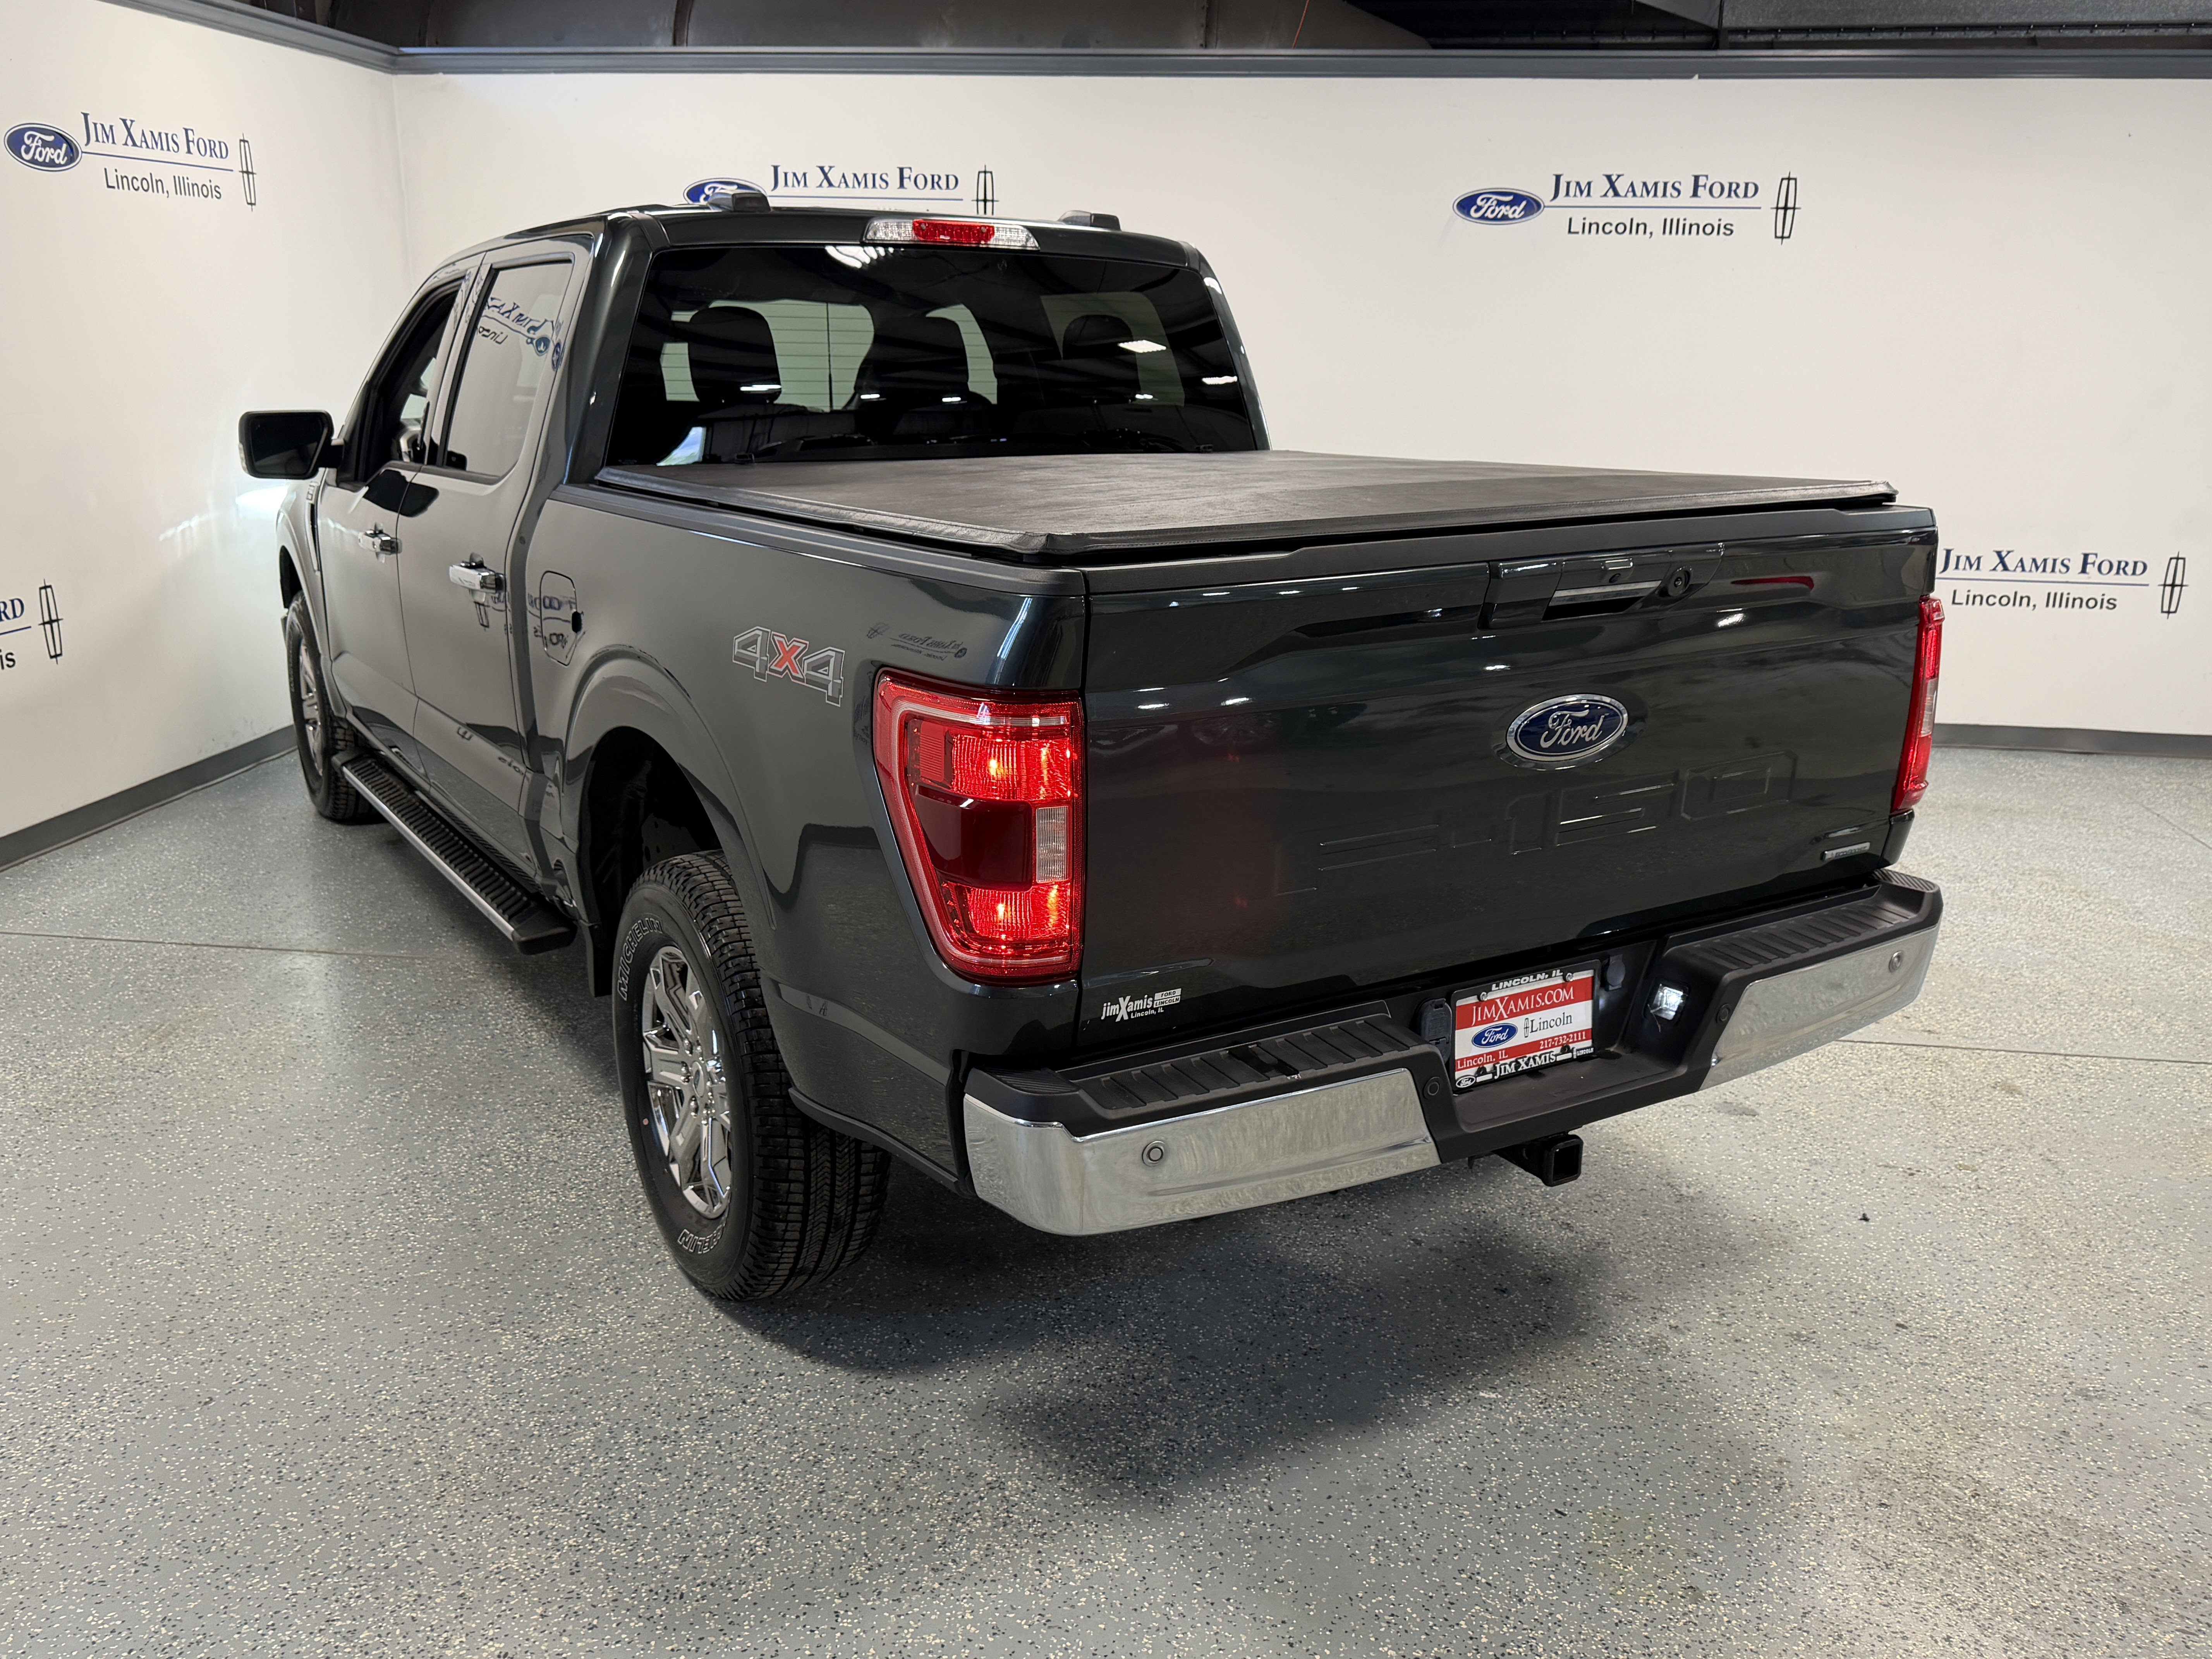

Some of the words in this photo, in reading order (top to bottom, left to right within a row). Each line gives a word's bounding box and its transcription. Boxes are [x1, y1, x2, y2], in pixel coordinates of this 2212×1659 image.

[21, 131, 68, 164] Ford
[81, 112, 117, 146] JIM
[120, 118, 179, 153] XAMIS
[183, 128, 228, 159] FORD
[104, 168, 169, 198] Lincoln,
[173, 175, 222, 199] Illinois
[771, 165, 808, 191] JIM
[816, 165, 889, 189] XAMIS
[897, 167, 959, 190] FORD
[1550, 173, 1592, 201] JIM
[1600, 173, 1682, 199] XAMIS
[1690, 174, 1759, 199] FORD
[1470, 195, 1525, 218] Ford
[1568, 217, 1654, 239] Lincoln,
[1662, 218, 1734, 237] Illinois
[1939, 548, 1984, 574] JIM
[1989, 550, 2071, 575] XAMIS
[2078, 552, 2148, 576] FORD
[0, 598, 24, 622] RD
[1951, 589, 2037, 611] Lincoln,
[2045, 591, 2118, 610] Illinois
[1540, 709, 1610, 748] Ford
[617, 917, 663, 1001] MICHELIN
[1492, 973, 1548, 991] LINCOLN,
[1131, 1009, 1156, 1018] Lincoln,
[1155, 997, 1179, 1006] LINCOLN
[1472, 986, 1574, 1026] JIMXAMIS.COM
[1530, 1012, 1572, 1033] Lincoln
[1481, 1027, 1509, 1044] Ford
[1540, 1031, 1586, 1049] 217-732-2111
[1458, 1054, 1495, 1069] Lincoln,
[1499, 1050, 1508, 1059] IL
[1494, 1062, 1516, 1079] JIM
[1518, 1053, 1556, 1071] XAMIS
